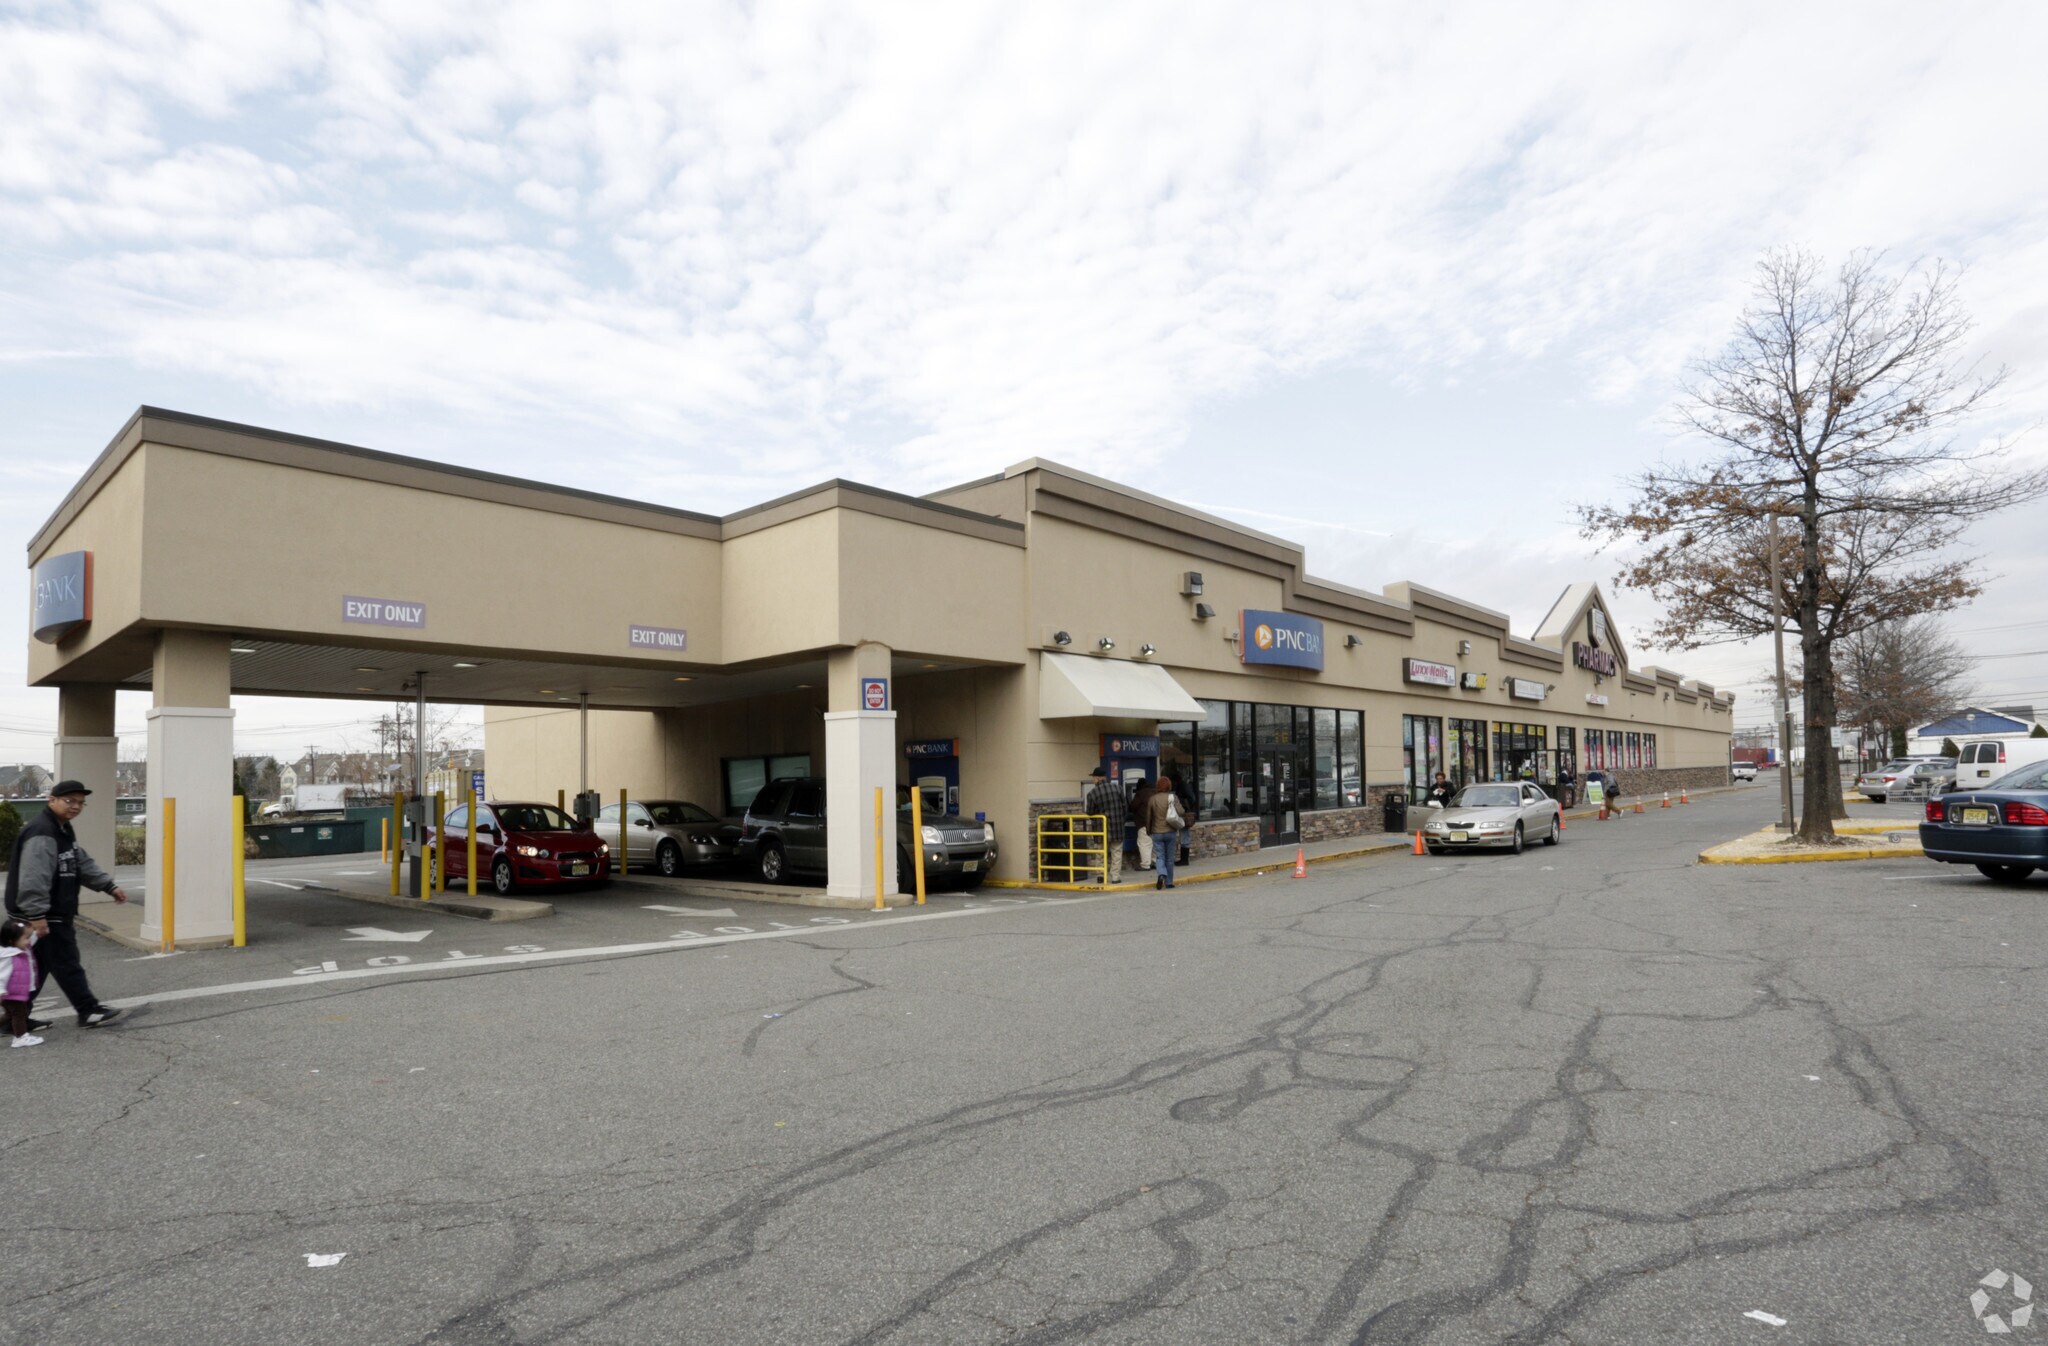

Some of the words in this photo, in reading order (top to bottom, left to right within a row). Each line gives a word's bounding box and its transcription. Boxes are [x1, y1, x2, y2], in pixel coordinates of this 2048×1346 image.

[346, 601, 382, 619] EXIT
[384, 605, 423, 623] ONLY
[632, 629, 656, 644] EXIT
[658, 632, 685, 647] ONLY
[1275, 628, 1305, 651] PNC
[1578, 641, 1617, 677] PHARMACY
[912, 744, 927, 754] PNC
[927, 743, 949, 753] BANK
[1122, 740, 1140, 751] PNC
[1140, 740, 1157, 751] BANK
